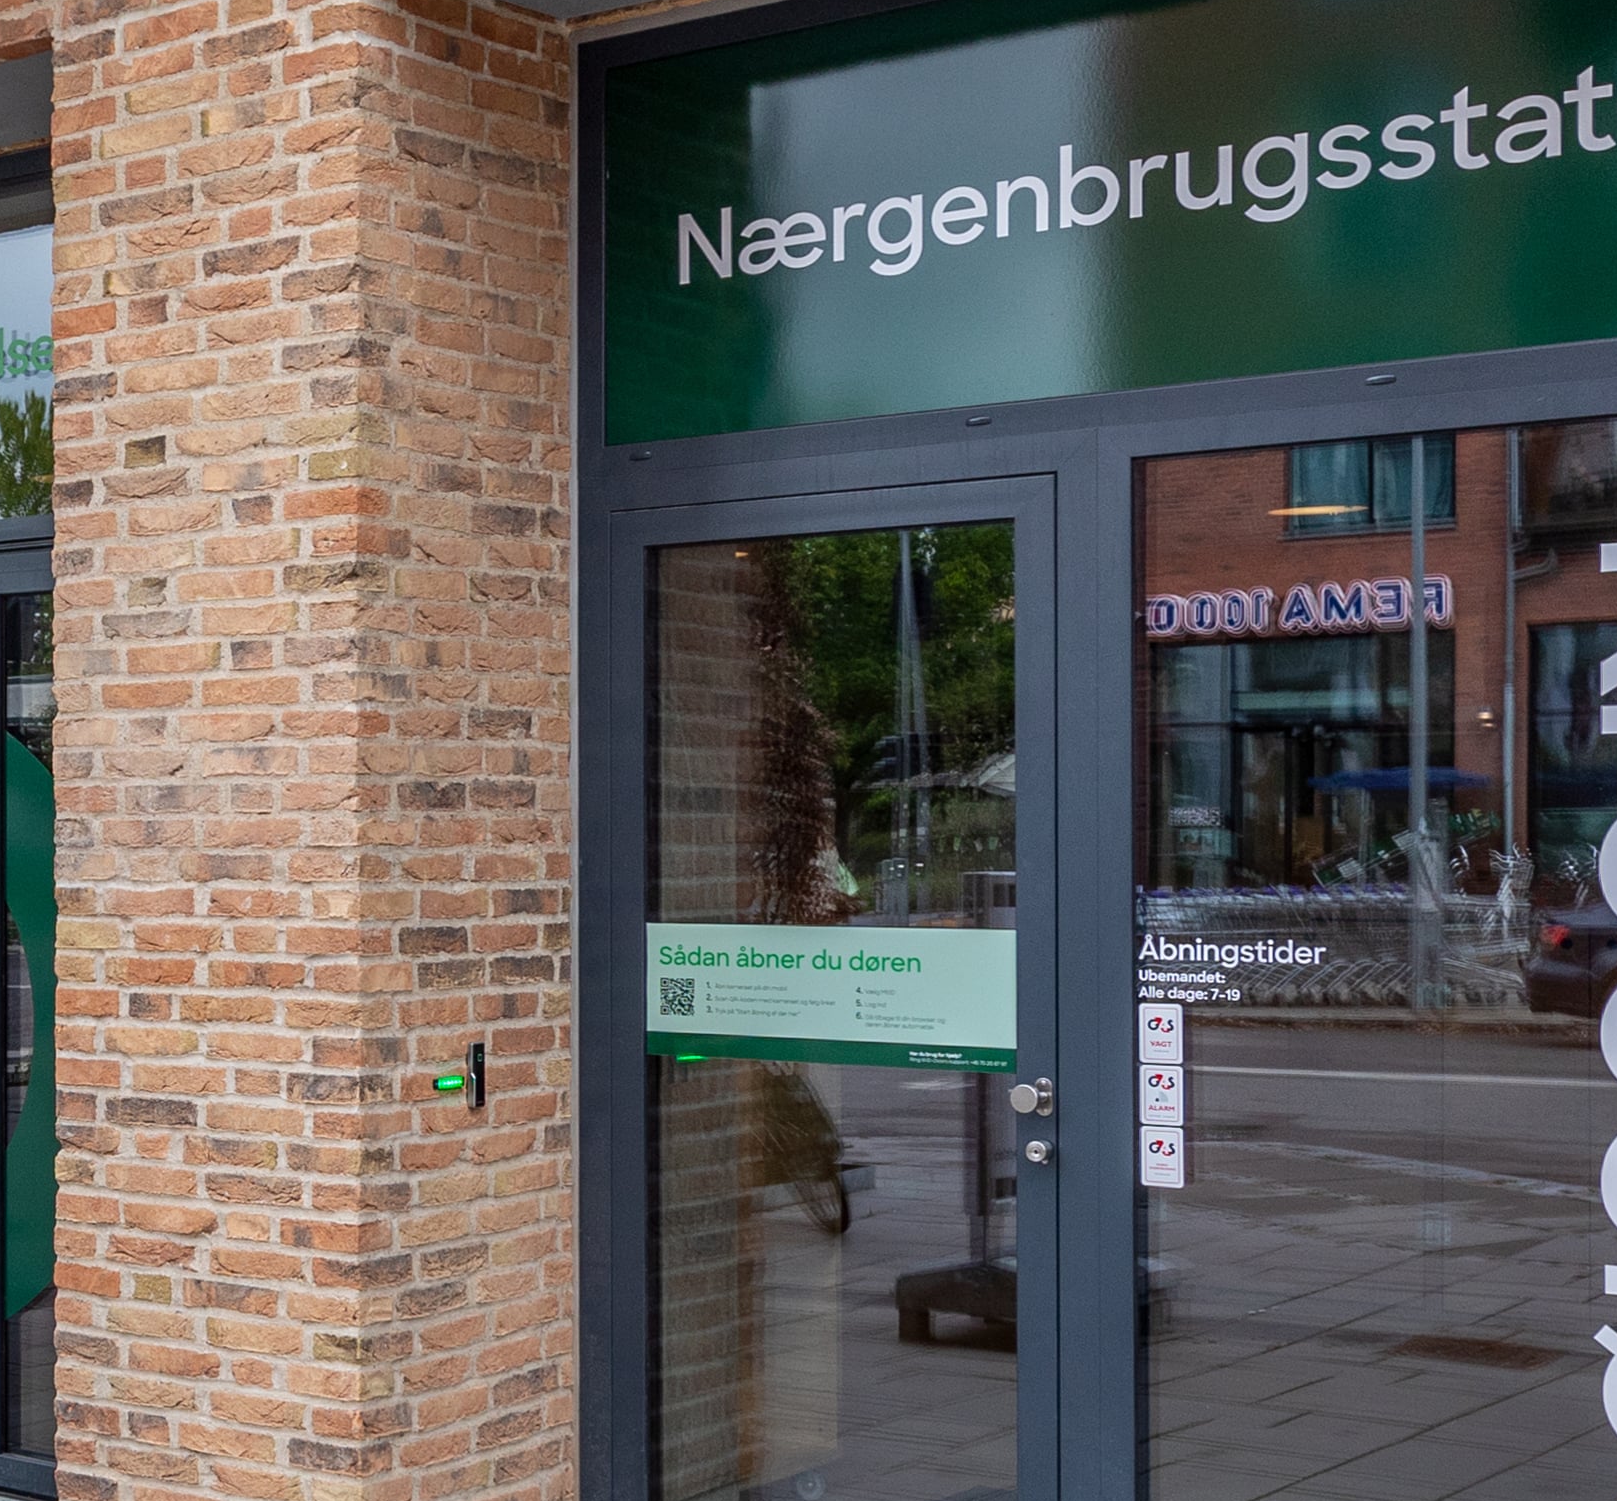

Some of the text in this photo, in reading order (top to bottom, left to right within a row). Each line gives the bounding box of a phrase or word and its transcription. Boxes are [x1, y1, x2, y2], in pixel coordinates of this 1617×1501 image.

[1138, 934, 1327, 968] Åbningstider
[659, 944, 921, 973] Sådan åbner du døren
[1138, 970, 1226, 983] Ubemandet:
[1138, 986, 1165, 999] Alle
[1167, 987, 1209, 1002] dage:
[1149, 1040, 1173, 1048] VAGT
[1148, 1104, 1175, 1112] ALARM
